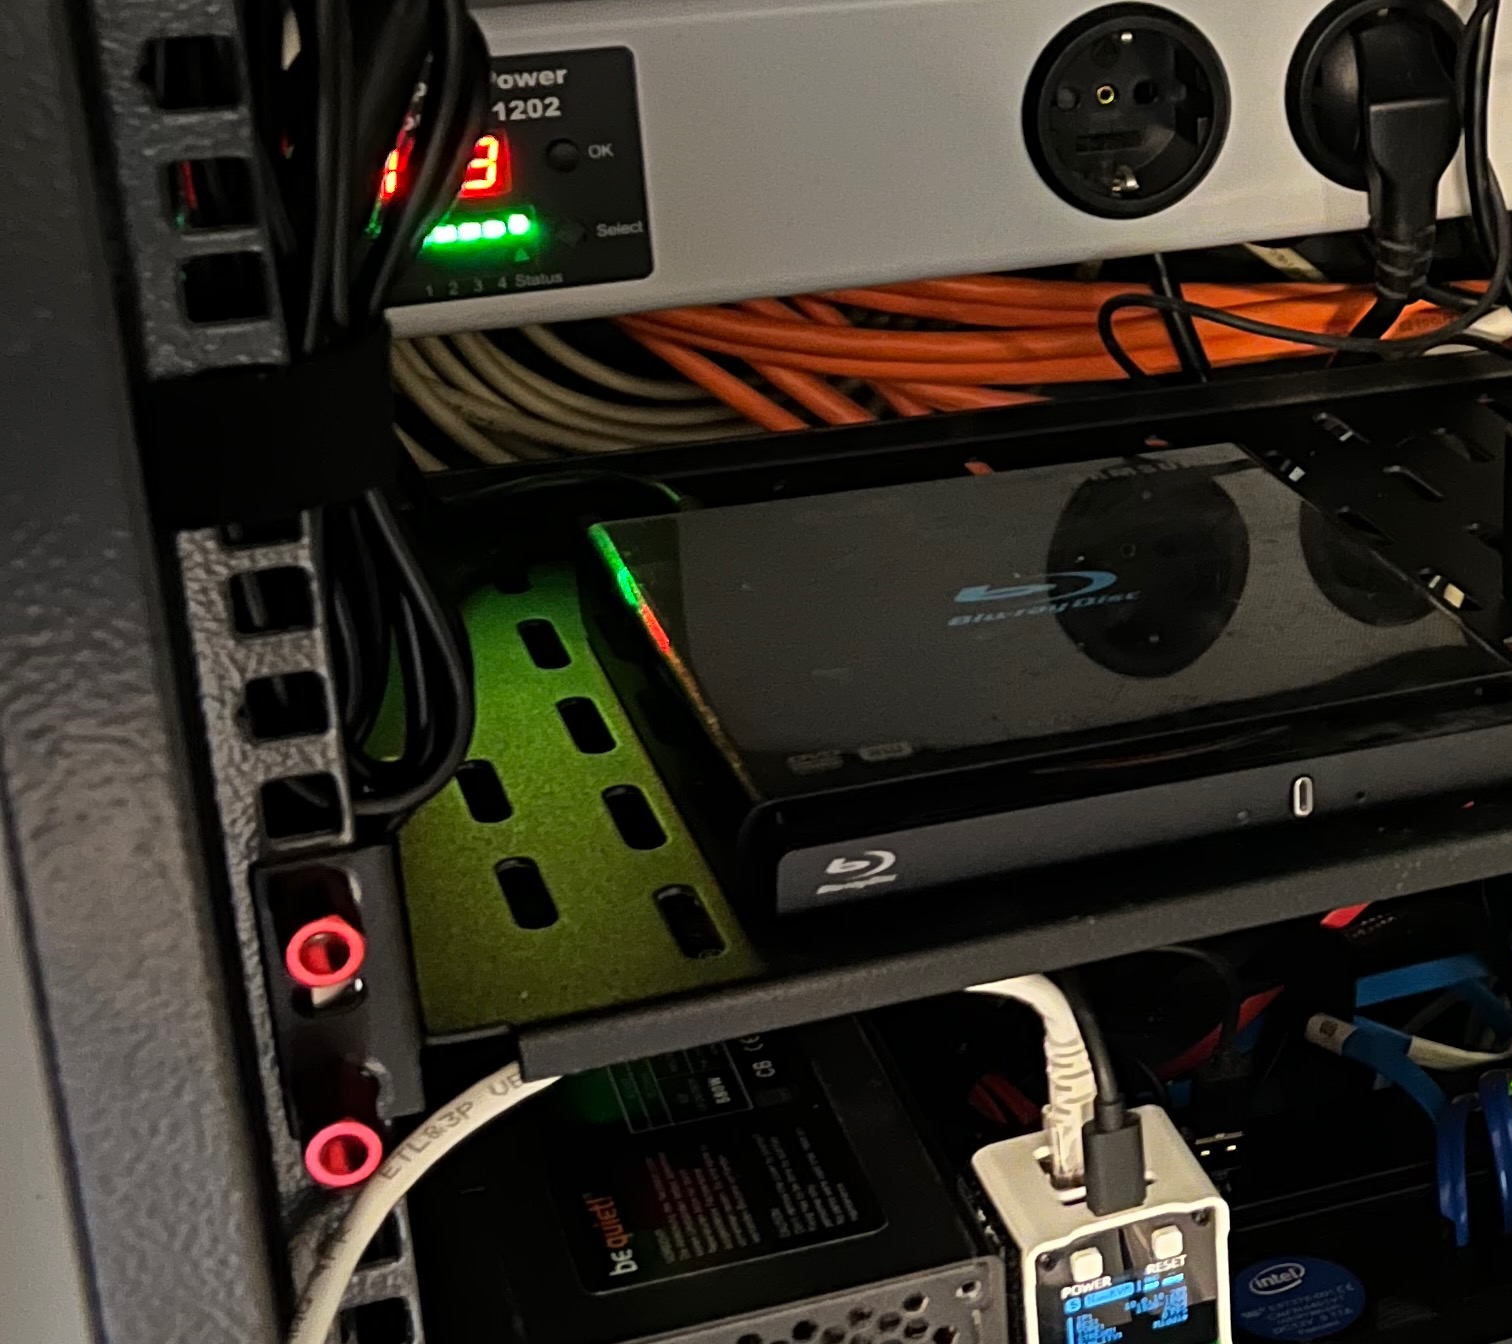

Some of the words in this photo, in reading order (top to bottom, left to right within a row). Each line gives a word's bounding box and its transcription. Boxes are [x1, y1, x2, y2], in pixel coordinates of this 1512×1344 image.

[490, 68, 569, 91] ower
[587, 142, 615, 160] OK
[595, 219, 645, 239] Select
[514, 271, 564, 289] Status
[1146, 1254, 1188, 1276] RESET
[1060, 1275, 1113, 1300] POWER
